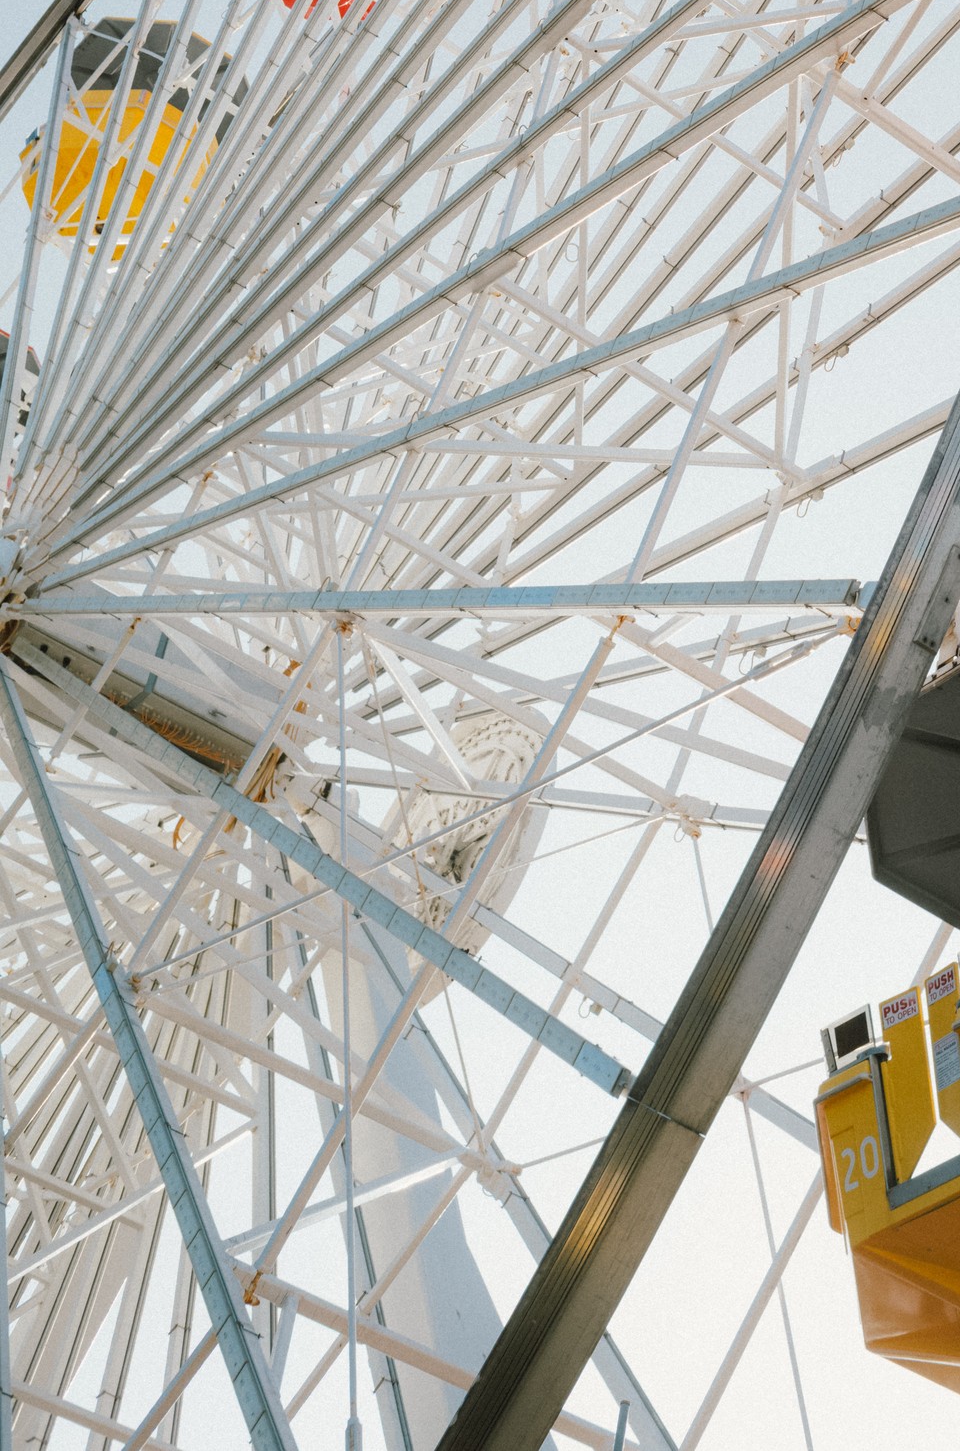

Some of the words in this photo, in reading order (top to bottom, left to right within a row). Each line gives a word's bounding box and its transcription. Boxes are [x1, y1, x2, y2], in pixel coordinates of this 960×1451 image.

[928, 970, 954, 994] PUSH
[930, 992, 937, 1001] TO
[939, 983, 954, 996] OPEN
[883, 997, 916, 1018] PUSH
[886, 1016, 895, 1025] TO
[898, 1006, 916, 1020] OPEN
[841, 1135, 879, 1192] 20
